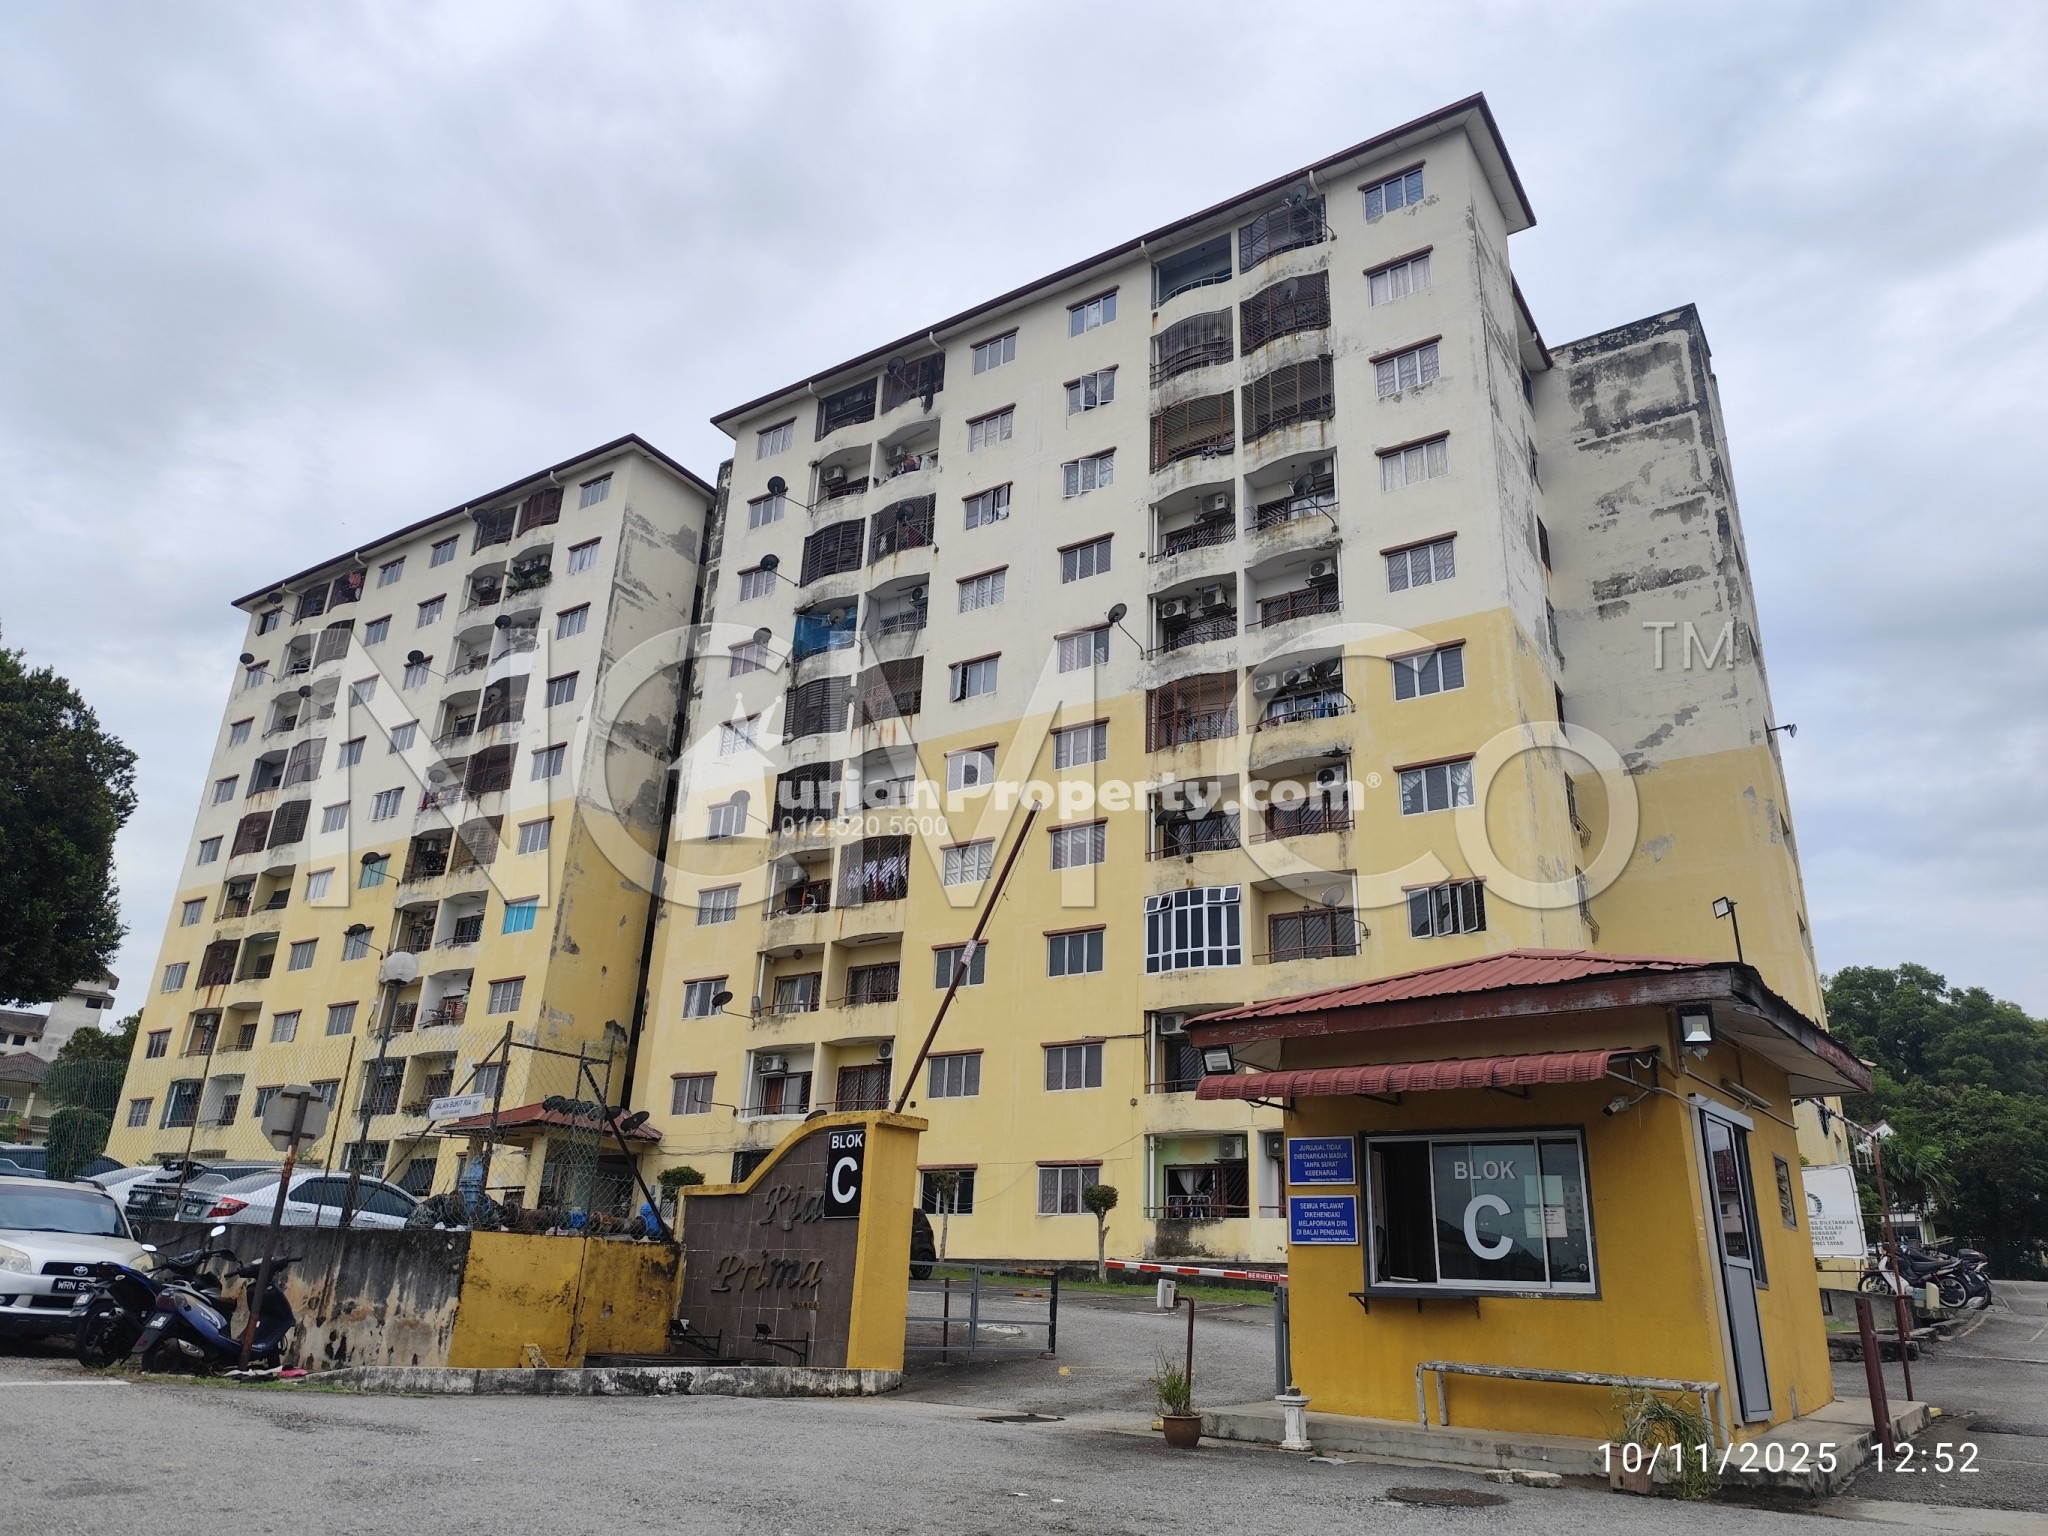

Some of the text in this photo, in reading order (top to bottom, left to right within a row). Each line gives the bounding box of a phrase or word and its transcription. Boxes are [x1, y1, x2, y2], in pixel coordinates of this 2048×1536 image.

[435, 1099, 472, 1110] JALAN BUKIT RIA
[831, 1133, 864, 1149] BLOK
[831, 1156, 858, 1204] C
[1454, 1160, 1516, 1180] BLOK
[760, 1182, 824, 1232] Ria
[1463, 1194, 1514, 1260] C
[711, 1250, 824, 1293] Prima
[1247, 1272, 1279, 1281] BERHENTI
[57, 1280, 76, 1291] WRN
